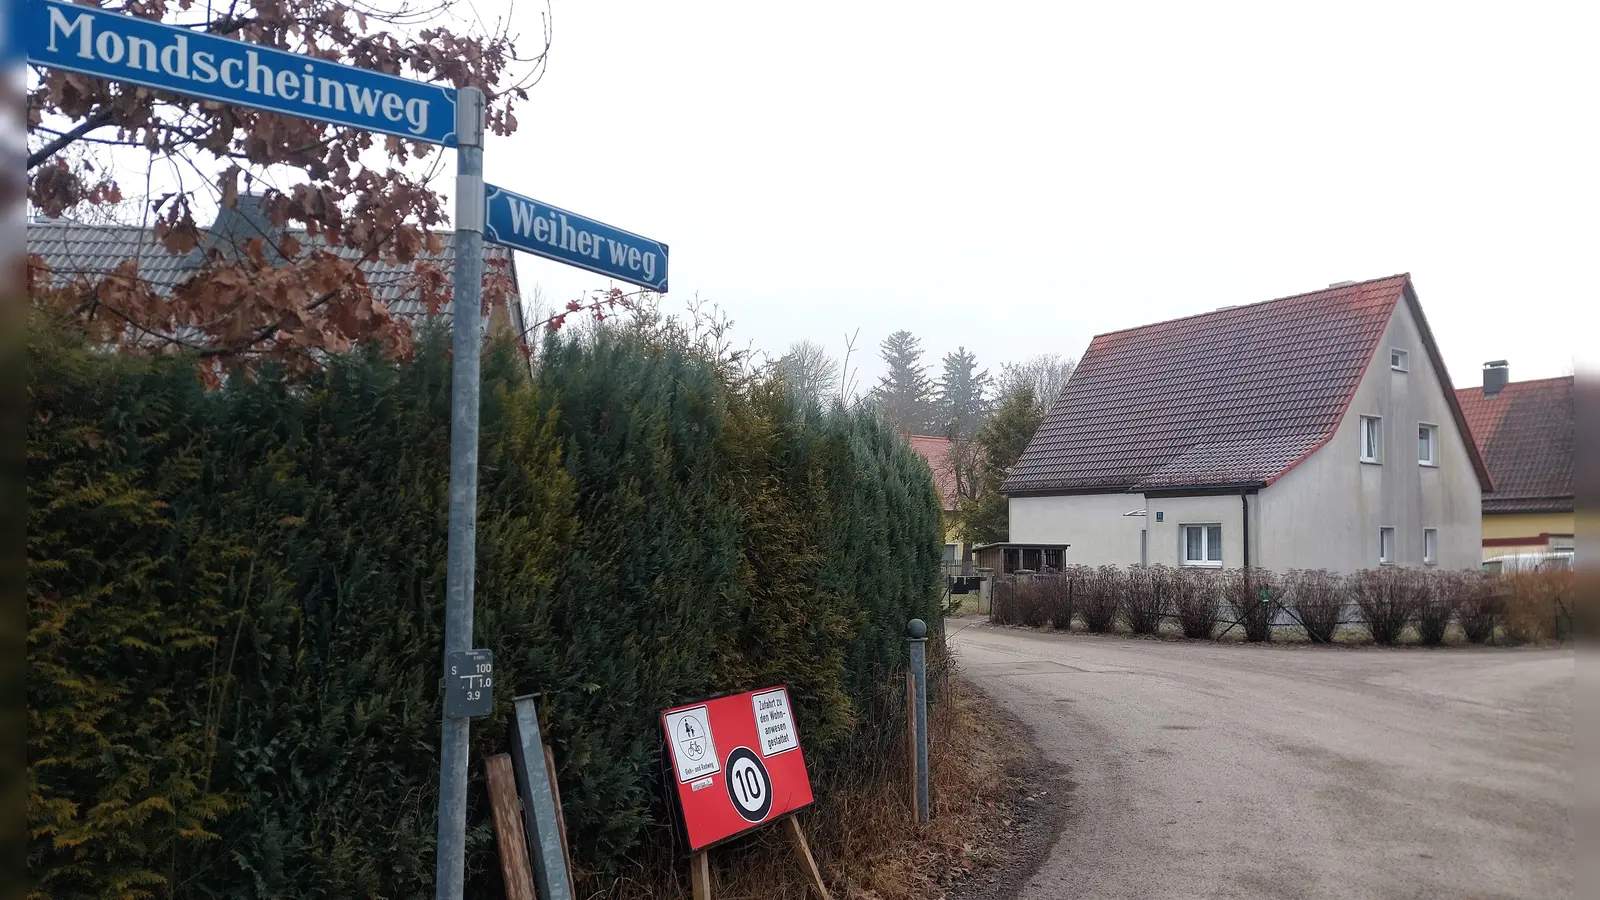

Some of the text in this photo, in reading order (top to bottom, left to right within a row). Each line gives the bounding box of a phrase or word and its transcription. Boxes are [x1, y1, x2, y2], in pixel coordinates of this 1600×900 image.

[46, 5, 430, 134] Mondscheinweg
[506, 195, 657, 282] Weiherweg
[451, 663, 492, 676] S 100
[479, 677, 492, 688] 1.0
[466, 691, 480, 700] 3.9
[758, 698, 782, 710] Zufahrt zu
[760, 709, 786, 723] den Wohn-
[764, 722, 787, 735] anwesen
[767, 733, 789, 749] gestattet
[735, 766, 761, 803] 10
